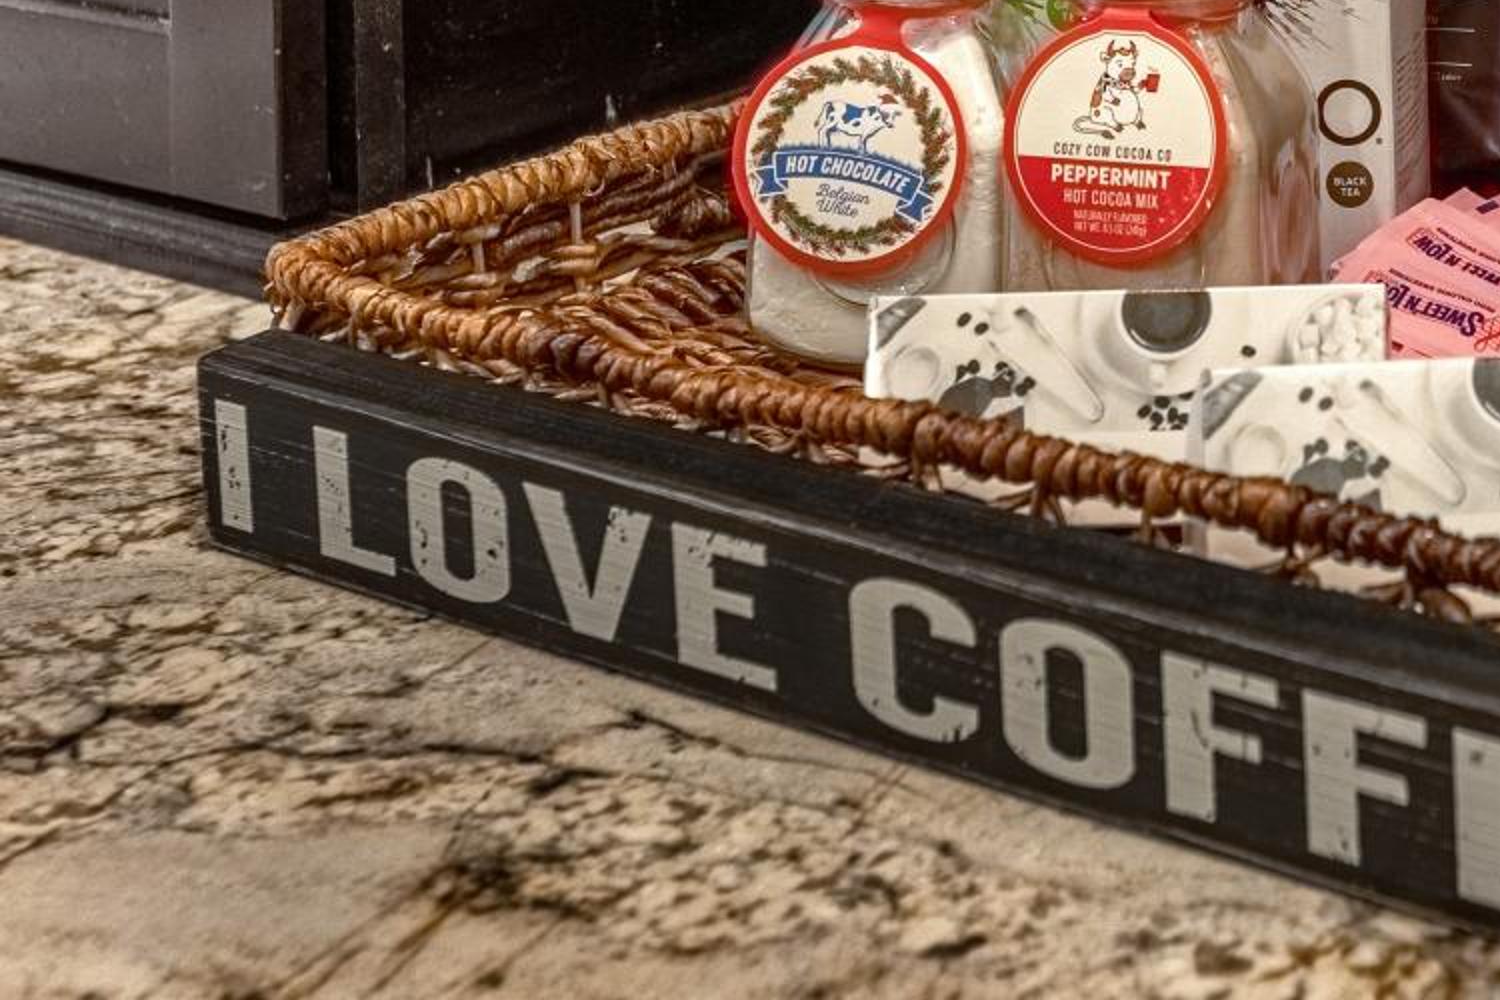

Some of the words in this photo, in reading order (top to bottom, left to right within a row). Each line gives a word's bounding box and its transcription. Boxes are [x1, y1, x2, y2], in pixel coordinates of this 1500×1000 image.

[1053, 141, 1083, 156] COZY
[1085, 144, 1111, 158] COW
[1115, 146, 1153, 161] COCOA
[784, 154, 819, 173] HOT
[820, 156, 912, 194] CHOCOLATE
[1050, 162, 1172, 191] PEPPERMINT
[1332, 176, 1367, 188] BLACK
[815, 183, 870, 205] Belgian
[1062, 187, 1088, 205] HOT
[1091, 189, 1133, 208] COCOA
[1135, 192, 1160, 210] MIX
[1340, 187, 1361, 197] TEA
[815, 198, 859, 218] White
[1381, 279, 1411, 310] LO
[212, 399, 255, 534] I
[311, 424, 778, 693] LOVE
